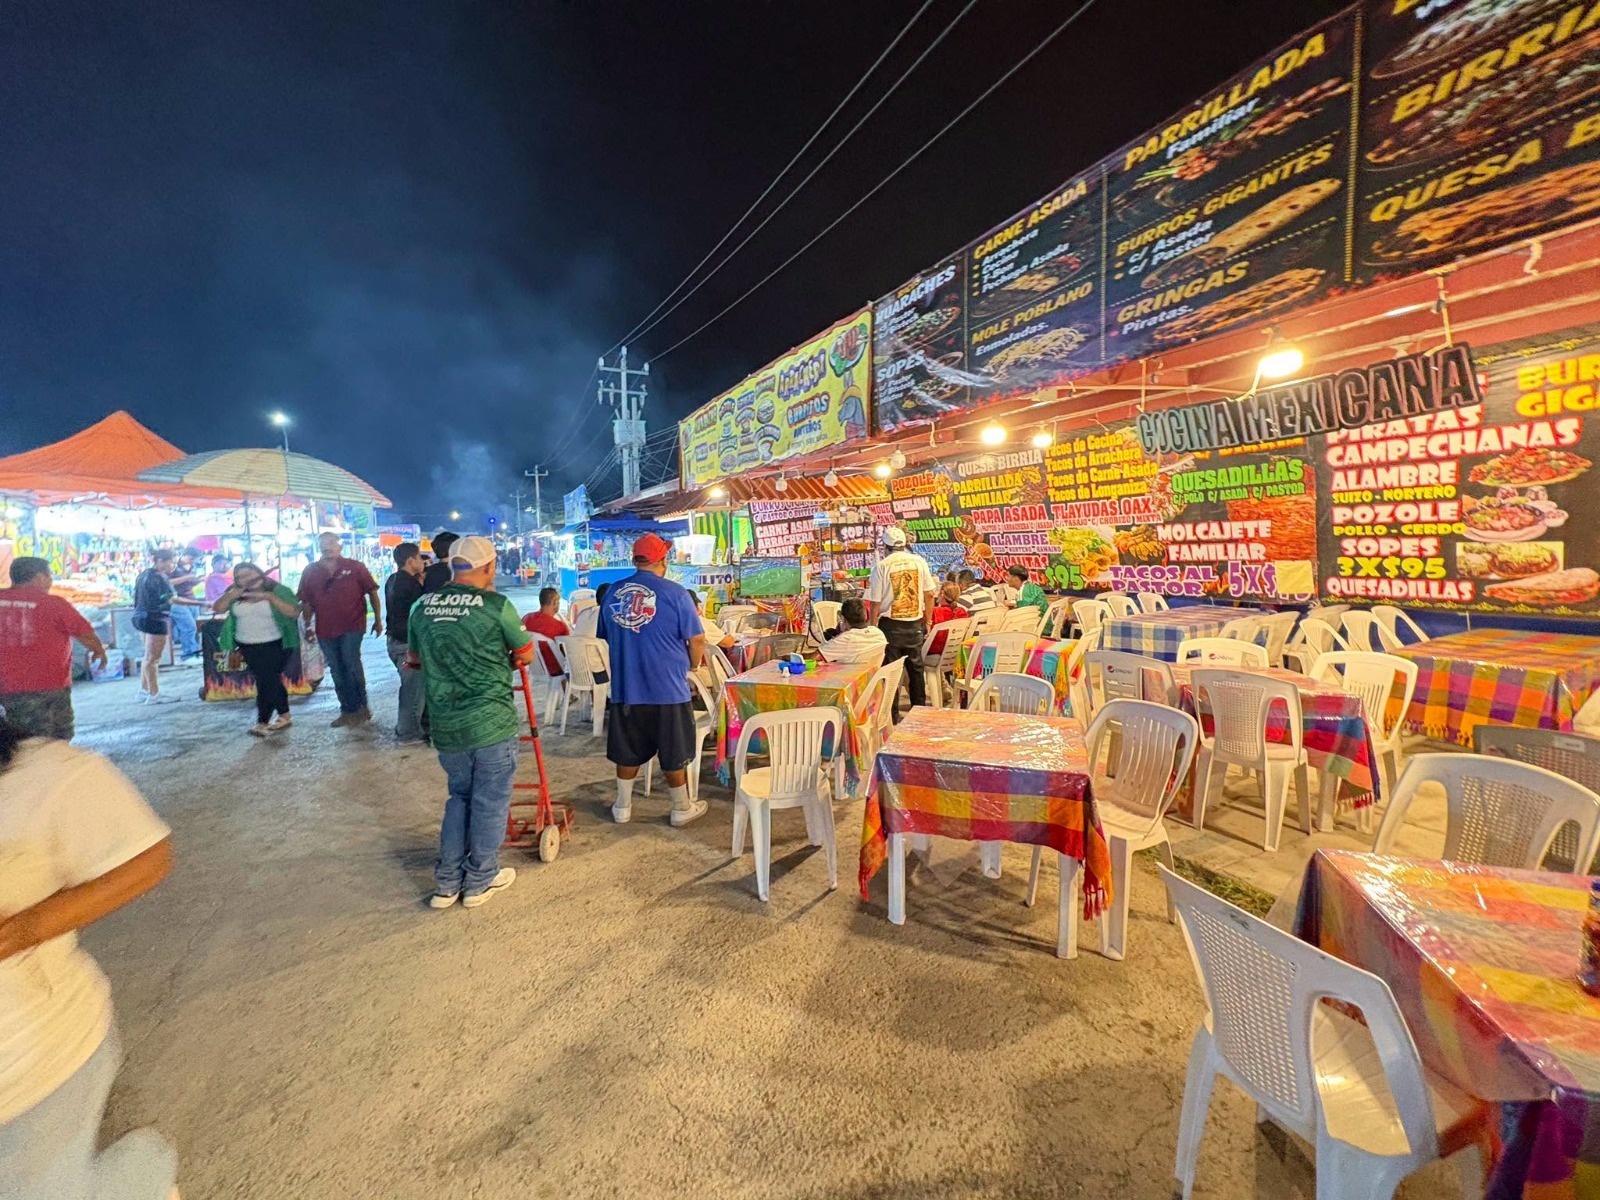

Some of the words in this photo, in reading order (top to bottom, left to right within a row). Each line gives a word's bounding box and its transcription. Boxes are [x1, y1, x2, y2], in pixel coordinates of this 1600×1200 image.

[1124, 33, 1326, 171] PARRILLADA
[1166, 98, 1260, 159] Familiar
[1369, 139, 1541, 222] QUESA
[1116, 207, 1198, 257] BURROS
[1203, 143, 1334, 215] GIGANTES
[974, 218, 1025, 259] CARNE
[1027, 181, 1087, 229] ASADA
[1152, 220, 1213, 253] Asada
[1030, 243, 1068, 268] Asada
[1151, 232, 1215, 265] Pastor
[875, 265, 956, 325] HUARACHES
[1117, 261, 1249, 323] GRINGAS
[972, 318, 1011, 345] MOLE
[1014, 282, 1093, 326] POBLANO
[877, 350, 925, 383] SOPES
[1136, 401, 1238, 454] COCINA
[1240, 347, 1480, 443] MEXICANA
[1516, 384, 1600, 418] GIG
[1073, 438, 1086, 453] de
[1087, 433, 1124, 450] Cecina
[1327, 418, 1581, 467] CAMPECHANAS
[997, 448, 1043, 470] BIRRIA
[1045, 457, 1074, 472] Tacos
[1074, 453, 1087, 468] de
[1089, 447, 1142, 466] Arrachera
[893, 473, 935, 491] POZOLE
[953, 471, 1024, 495] PARRILLADA
[1047, 473, 1075, 487] Tacos
[1076, 470, 1089, 484] de
[1090, 465, 1121, 482] Carne
[1123, 460, 1158, 478] Asada
[1172, 459, 1305, 492] QUESADILLAS
[1332, 463, 1458, 492] ALAMBRE
[959, 490, 1012, 508] FAMILIAR
[1048, 488, 1077, 502] Tacos
[1077, 485, 1090, 499] de
[1091, 479, 1148, 500] Longaniza
[1220, 488, 1248, 500] ASADA
[1266, 482, 1305, 497] PASTOR
[1332, 490, 1373, 504] SUIZO
[1383, 485, 1457, 501] NORTEÑO
[931, 494, 951, 516] $95
[971, 508, 1002, 524] PAPA
[1004, 504, 1047, 521] ASADA
[1051, 502, 1119, 521] TLAYUDAS
[1332, 502, 1460, 525] POZOLE
[756, 523, 789, 538] CARNE
[934, 517, 962, 528] ESTILO
[1100, 515, 1131, 525] CHORIZO
[1157, 520, 1271, 541] MOLCAJETE
[1333, 525, 1388, 536] POLLO
[1401, 522, 1467, 535] CERDO
[757, 531, 814, 551] ARRACHERA
[918, 529, 948, 540] JALISCO
[990, 533, 1049, 547] ALAMBRE
[1168, 542, 1267, 561] FAMILIAR
[1340, 537, 1440, 557] SOPES
[1045, 563, 1085, 590] $95
[1109, 565, 1181, 580] TACOS
[1184, 565, 1218, 580] AL
[1112, 580, 1204, 596] PASTOR
[1327, 577, 1475, 600] QUESADILLAS
[424, 607, 470, 616] COAHUILA
